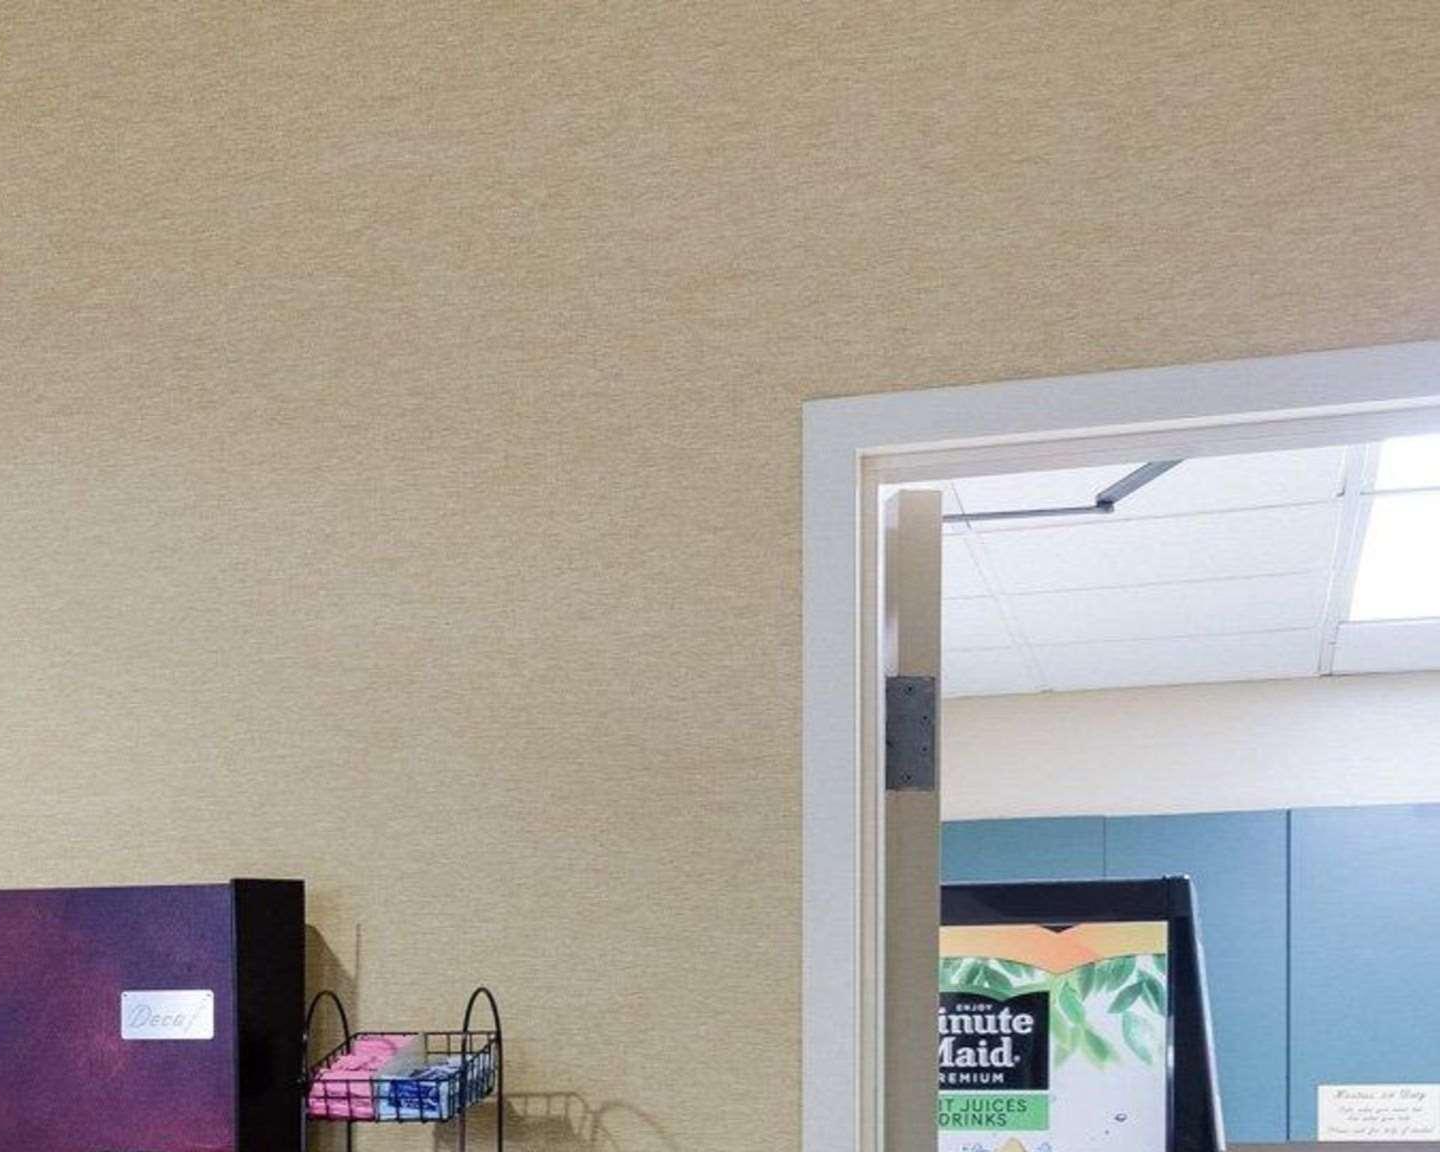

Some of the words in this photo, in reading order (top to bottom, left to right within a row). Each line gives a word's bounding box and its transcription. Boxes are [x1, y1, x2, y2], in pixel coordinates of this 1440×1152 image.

[955, 1003, 993, 1012] ENJOY
[938, 1006, 1035, 1035] inute
[938, 1072, 1004, 1083] REMIUM
[960, 1098, 1028, 1113] JUICES
